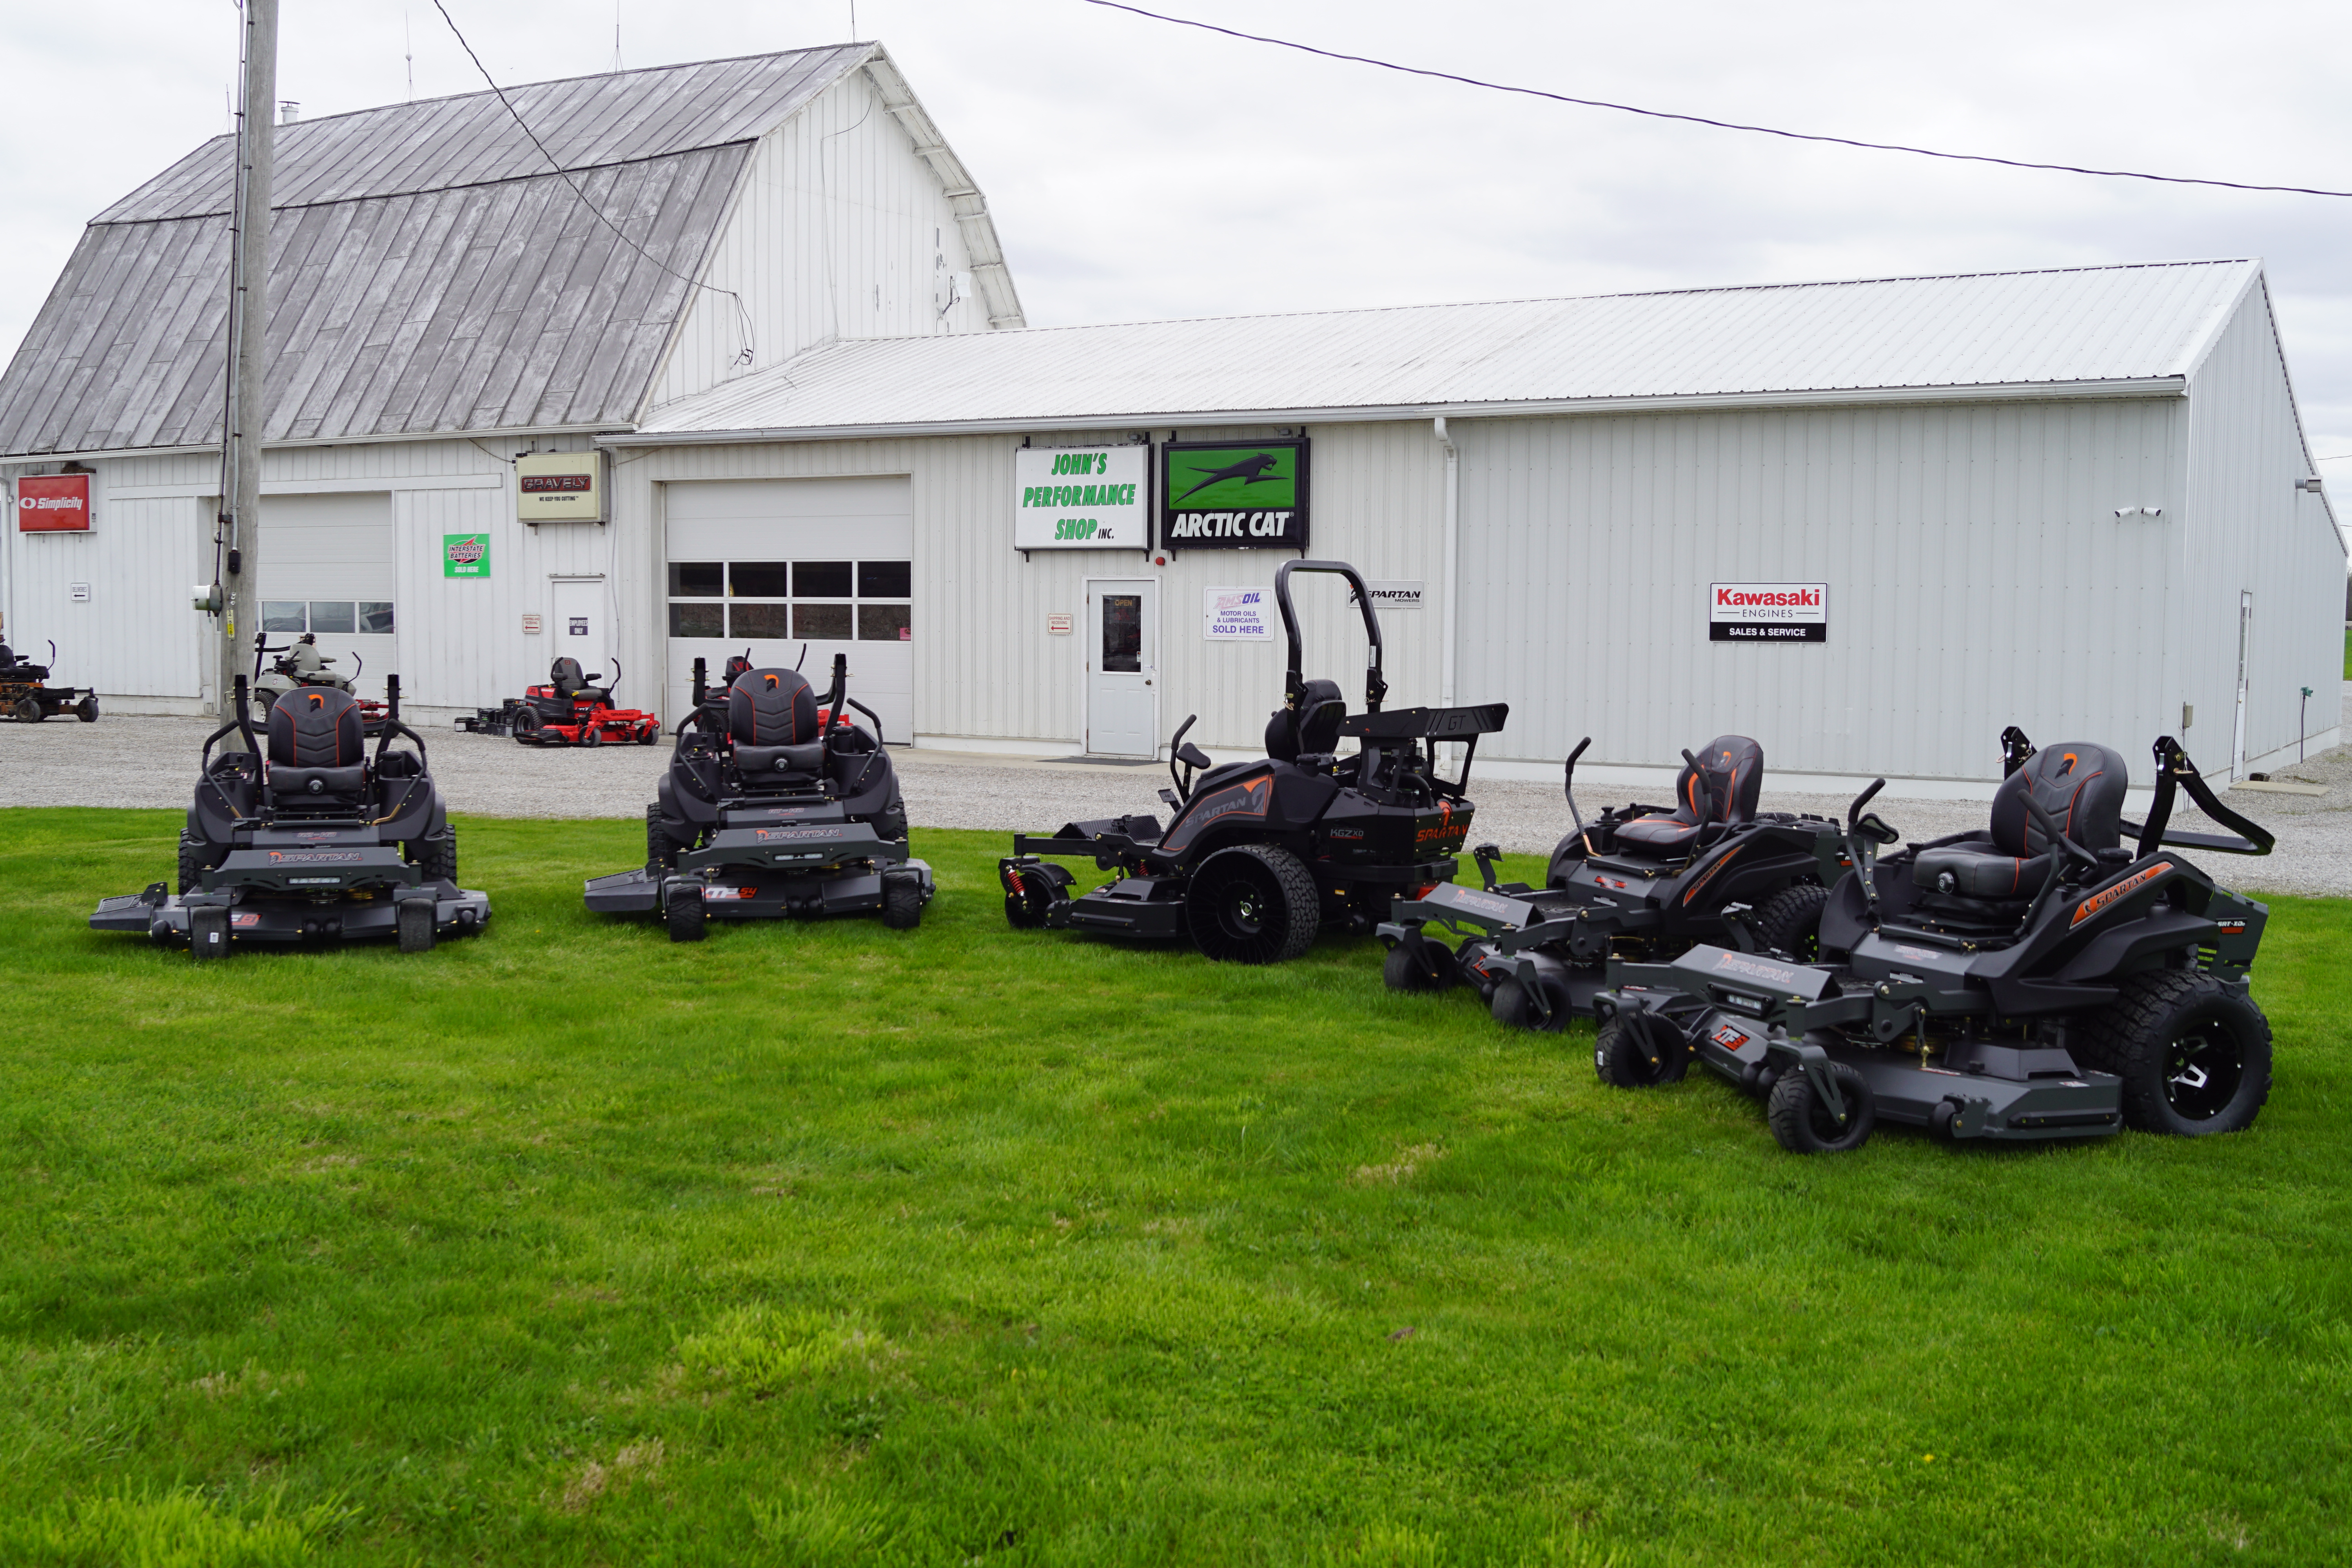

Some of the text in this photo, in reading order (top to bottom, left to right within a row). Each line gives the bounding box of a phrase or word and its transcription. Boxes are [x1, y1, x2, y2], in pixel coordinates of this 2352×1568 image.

[1051, 453, 1107, 475] JOHN'S
[524, 477, 588, 490] GRAVELY
[37, 496, 83, 511] Simplicity
[1022, 483, 1136, 507] PERFORMANCE
[1054, 518, 1114, 540] SHOP INC.
[1171, 512, 1246, 537] ARCTIC
[1214, 592, 1261, 609] AMSOIL
[1717, 588, 1820, 606] Kawasaki
[1742, 609, 1793, 618] ENGINES
[1212, 625, 1264, 634] SOLD HERE
[1448, 715, 1466, 730] GT
[1185, 796, 1246, 828] SPARTAN
[767, 829, 840, 840] SPARTAN
[1415, 824, 1469, 842] SPARTAN
[281, 853, 360, 862] SPARTAN
[1693, 862, 1721, 889] SPARTAN
[2096, 873, 2146, 910] SPARTAN
